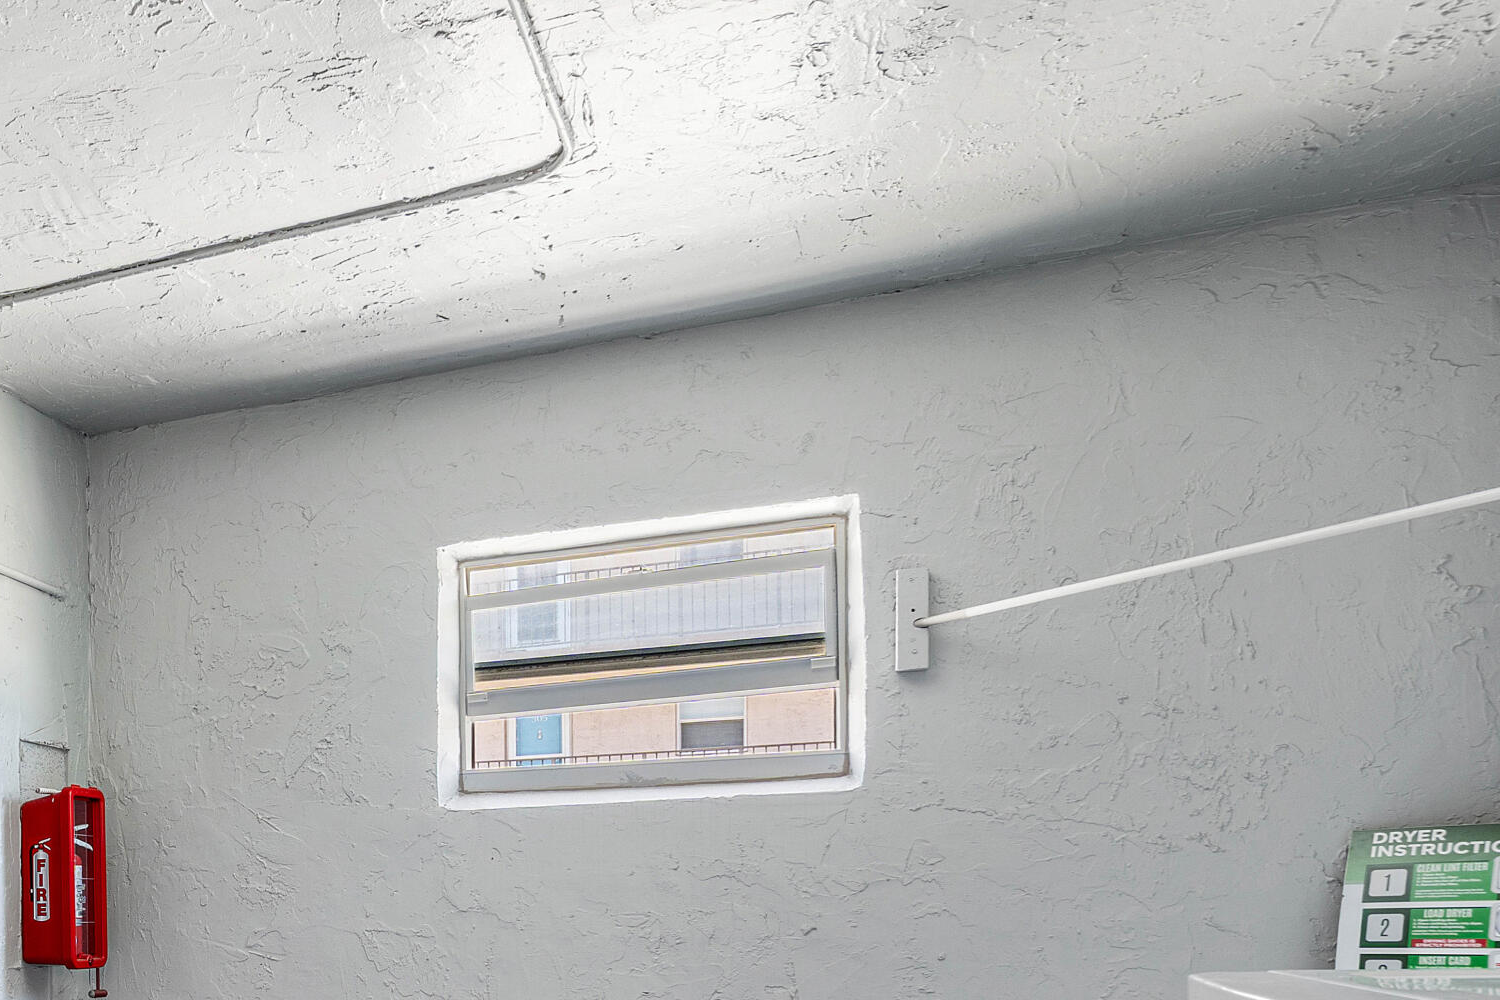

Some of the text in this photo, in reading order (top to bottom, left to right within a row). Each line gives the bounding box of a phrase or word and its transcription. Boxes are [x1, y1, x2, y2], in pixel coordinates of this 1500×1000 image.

[1372, 829, 1447, 844] DRYER
[37, 859, 47, 916] FIRE
[1384, 874, 1391, 892] 1
[1380, 918, 1389, 937] 2
